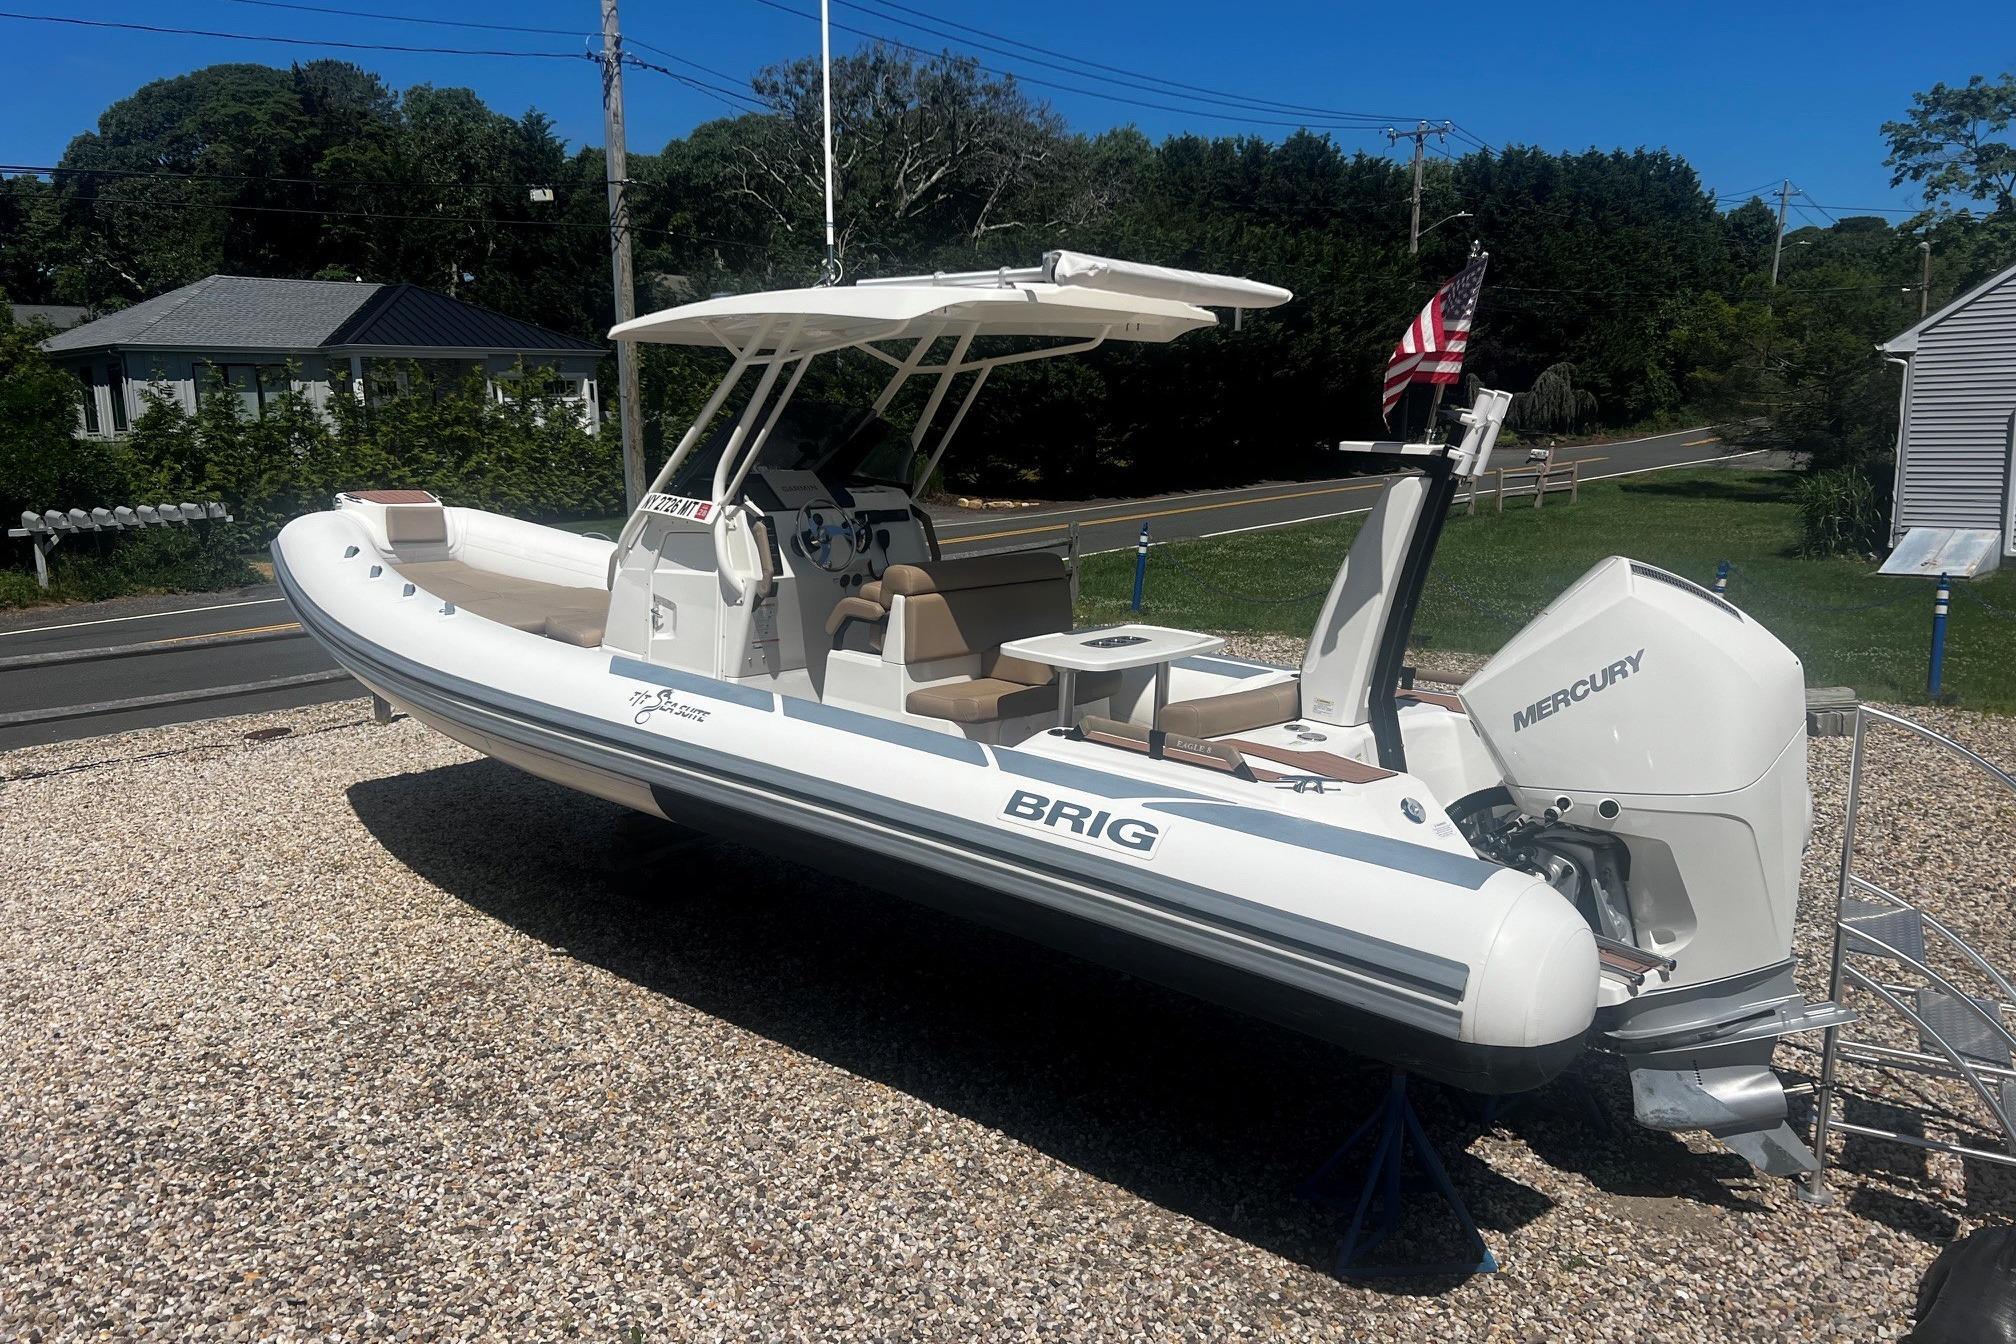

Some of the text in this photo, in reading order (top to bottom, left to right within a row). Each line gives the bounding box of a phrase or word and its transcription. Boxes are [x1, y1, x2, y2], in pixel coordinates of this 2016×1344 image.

[654, 496, 682, 514] 2726
[676, 500, 701, 517] MT
[1513, 648, 1645, 733] MERCURY
[1176, 740, 1205, 753] EAGLE
[1003, 789, 1159, 851] BRIG
